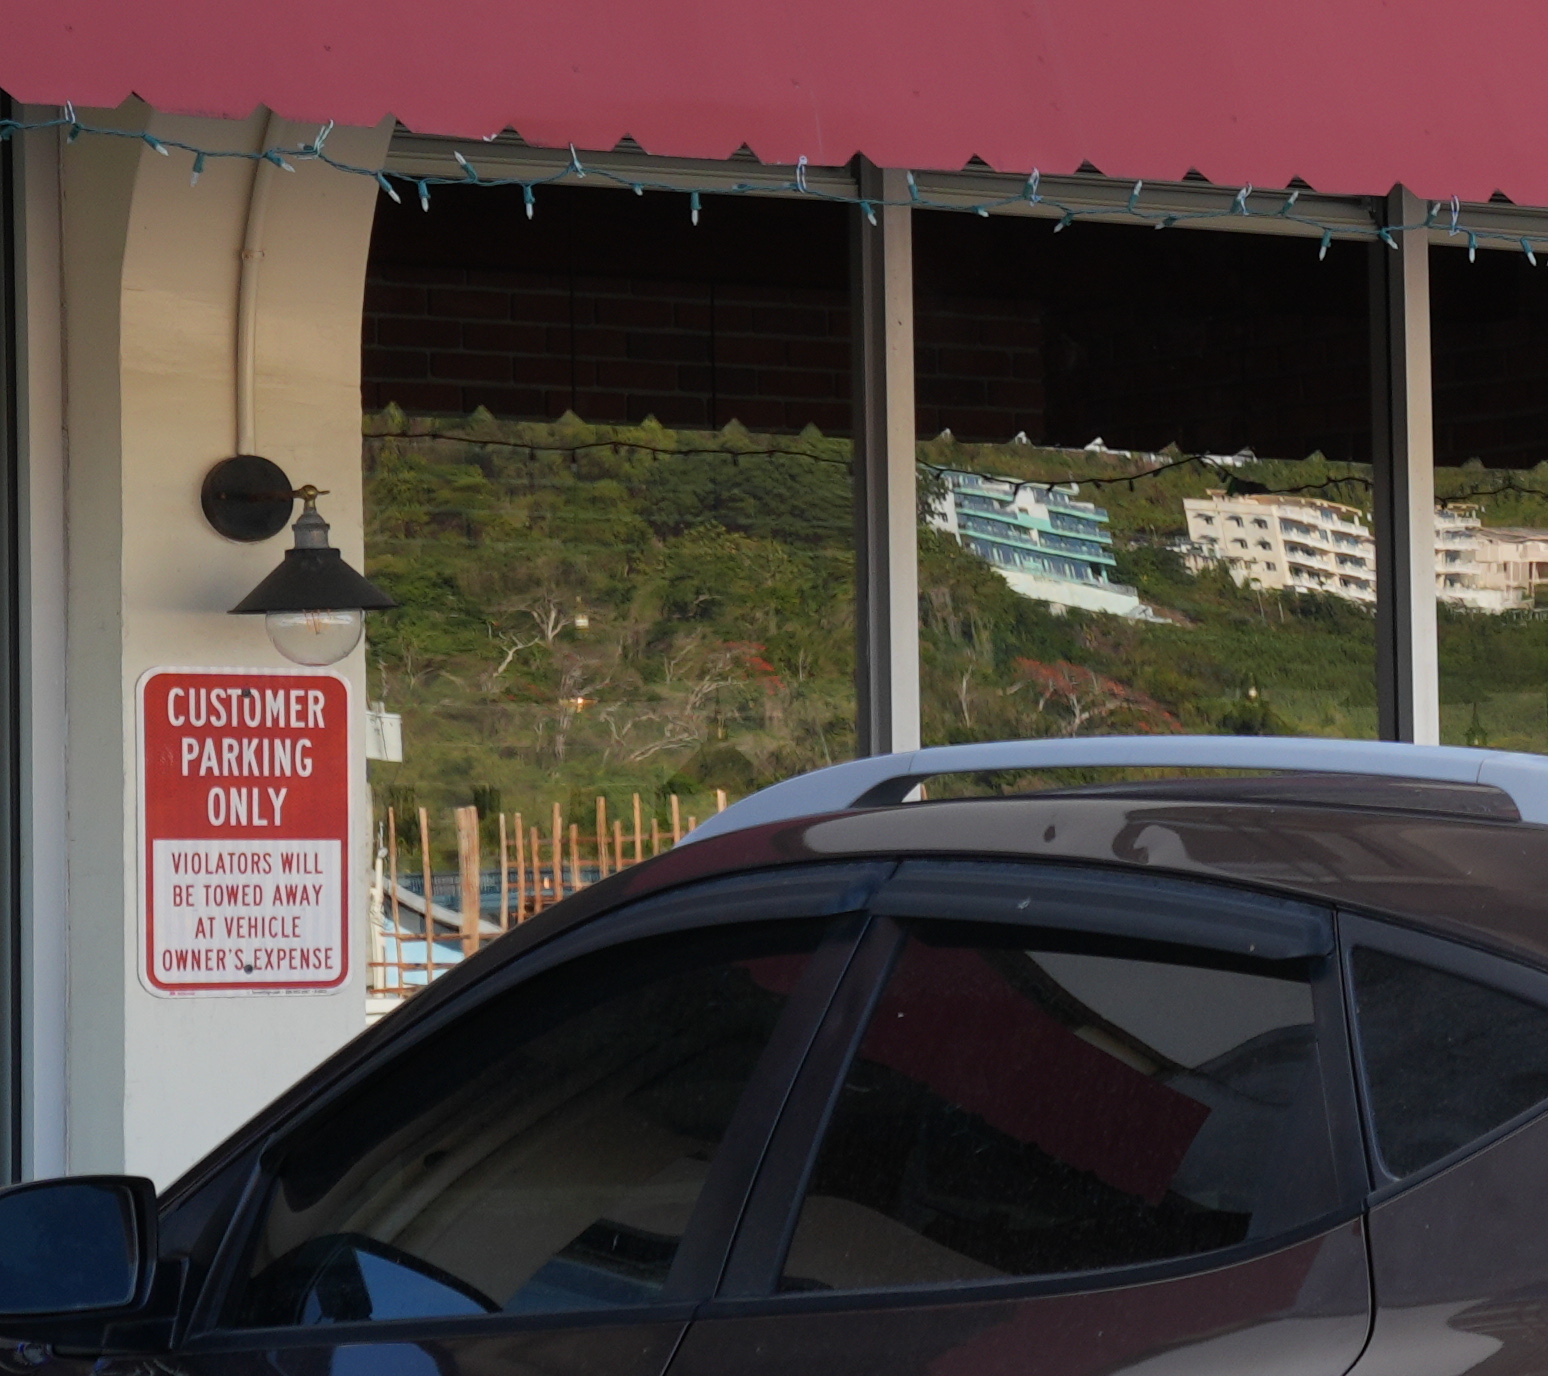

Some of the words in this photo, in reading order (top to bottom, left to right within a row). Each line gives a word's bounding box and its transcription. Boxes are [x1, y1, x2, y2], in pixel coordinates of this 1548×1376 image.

[167, 687, 326, 729] CUSTOMER
[181, 737, 313, 777] PARKING
[207, 786, 288, 827] ONLY
[171, 852, 273, 875] VIOLATORS
[280, 852, 324, 874] WILL
[172, 885, 195, 907] BE
[203, 885, 263, 907] TOWED
[272, 884, 324, 907] AWAY
[194, 917, 215, 939] AT
[225, 916, 301, 939] VEHICLE
[162, 948, 245, 972] OWNER'S
[252, 947, 334, 970] EXPENSE
